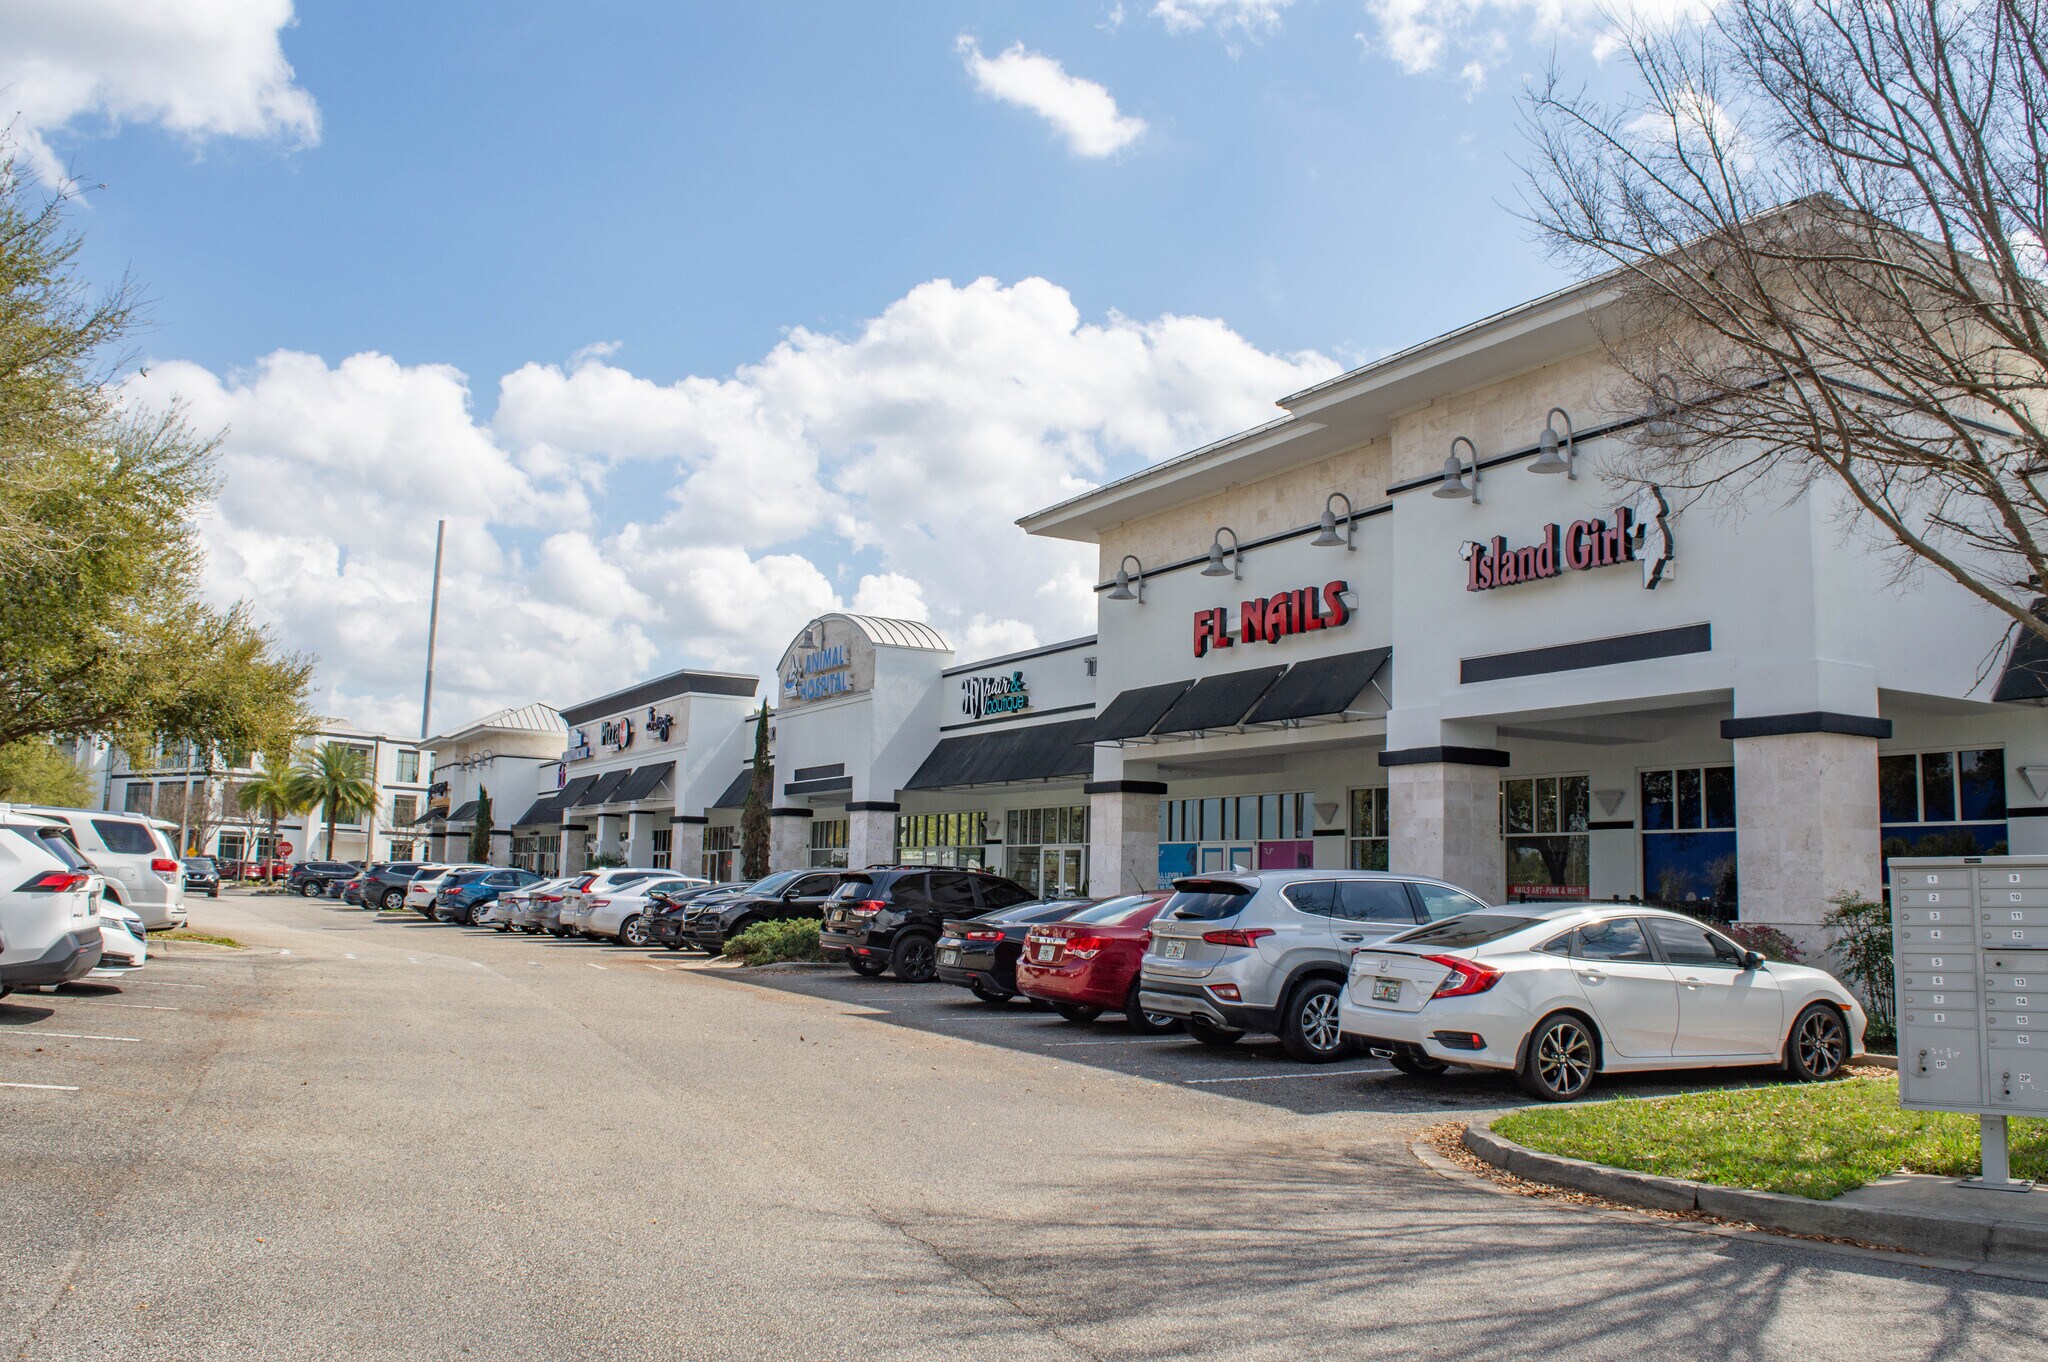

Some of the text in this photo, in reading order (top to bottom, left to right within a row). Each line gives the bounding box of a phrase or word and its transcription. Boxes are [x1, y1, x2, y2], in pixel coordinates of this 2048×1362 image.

[1466, 506, 1635, 592] Island Girl
[1194, 580, 1349, 658] FL NAILS
[804, 645, 844, 675] ANIMAL
[800, 671, 847, 701] HOSPITAL
[984, 676, 1011, 696] hair
[1010, 671, 1023, 692] &
[277, 845, 292, 853] STOP
[1513, 886, 1531, 894] NAILS
[1567, 886, 1586, 894] WHITE
